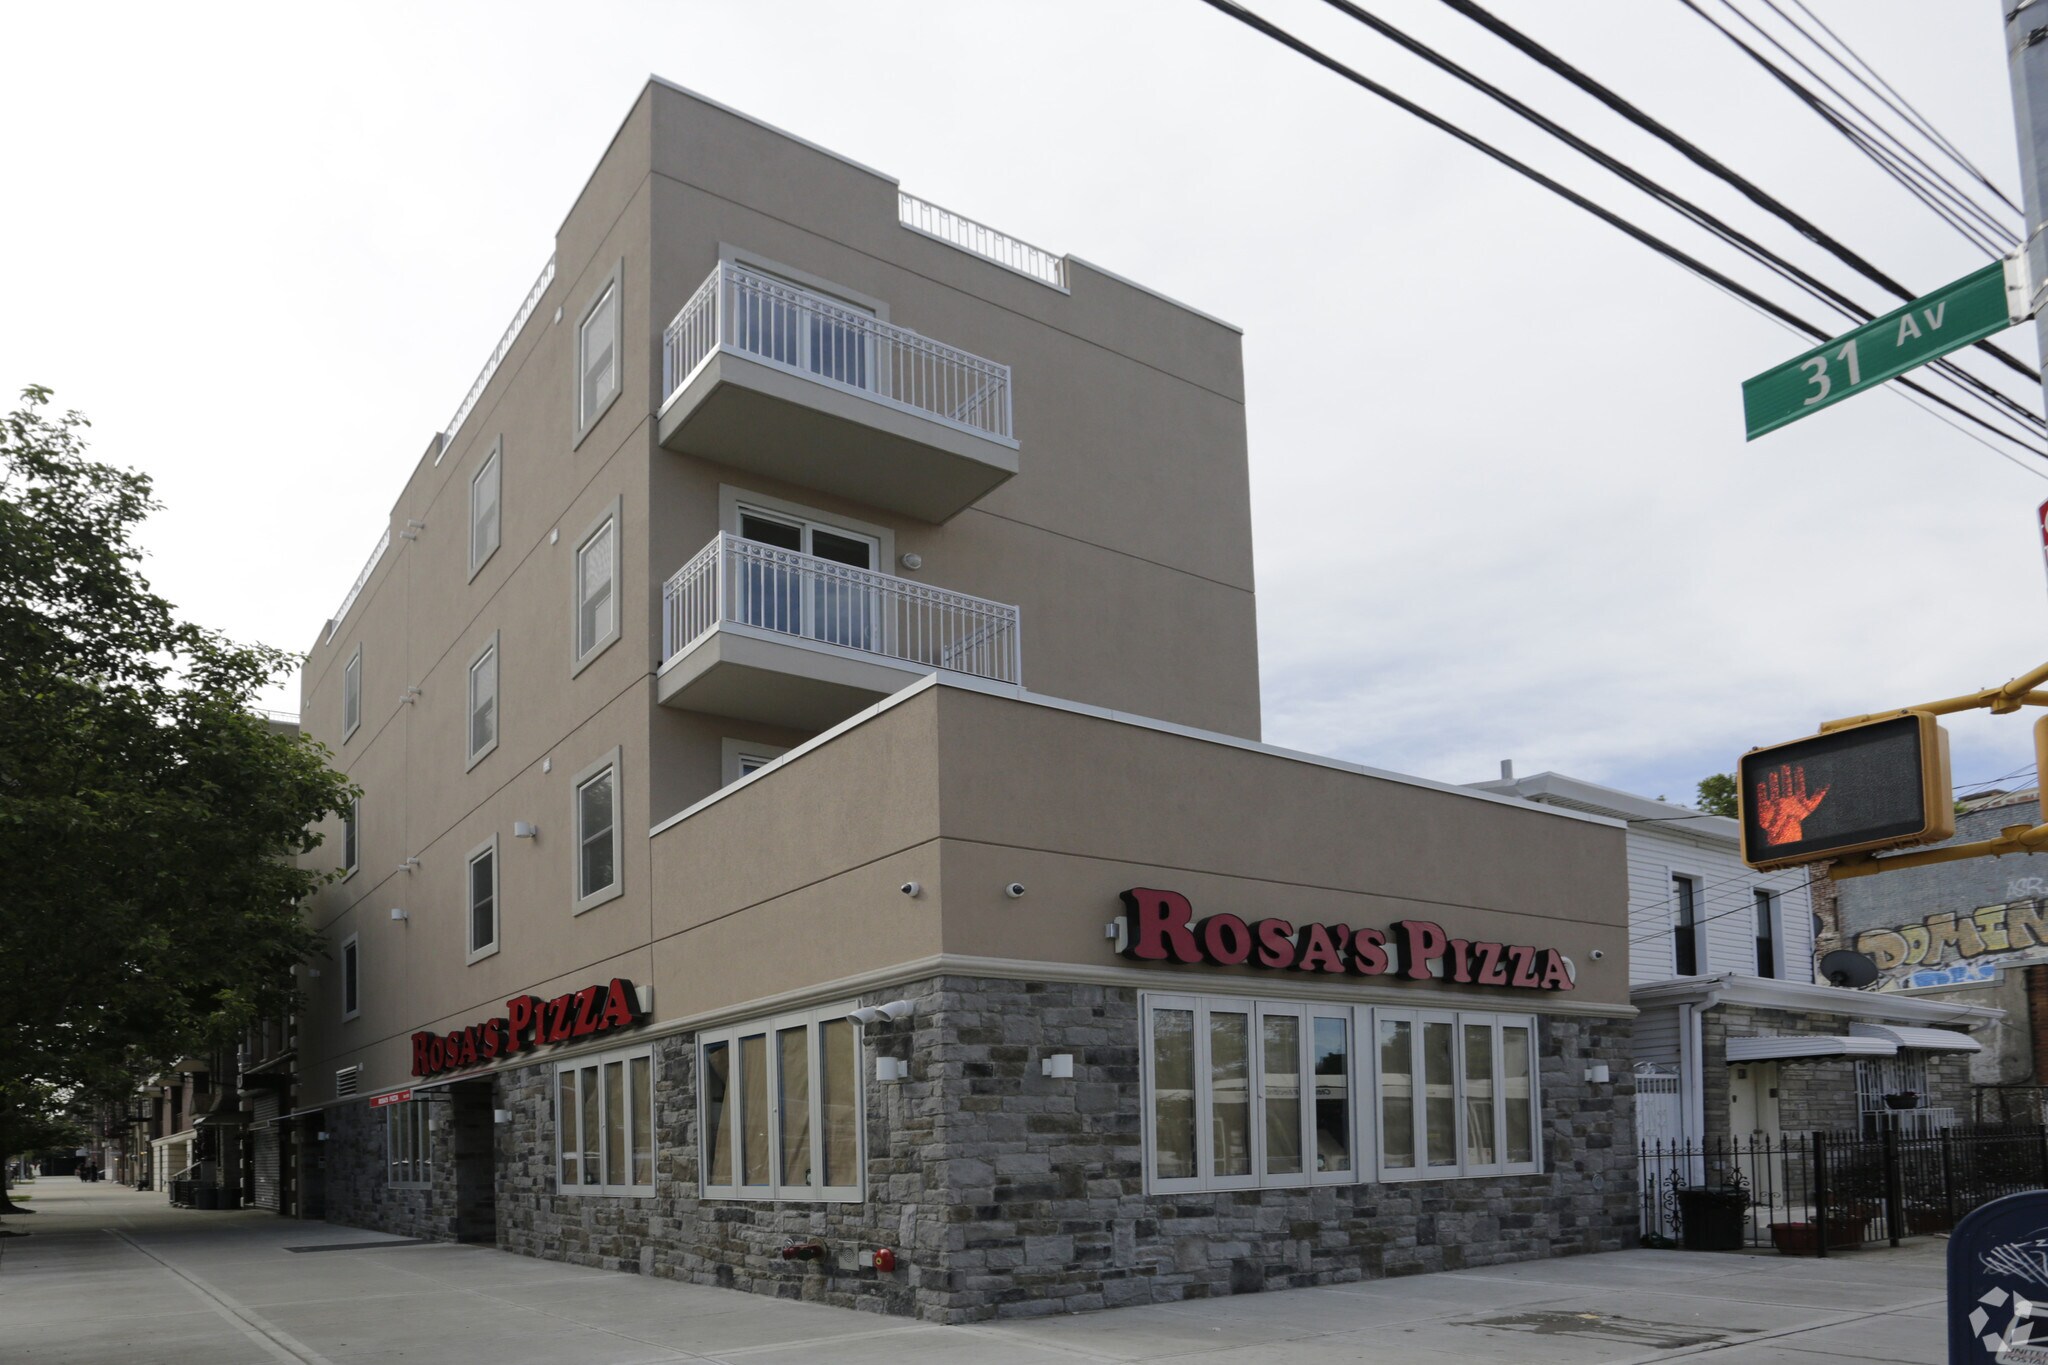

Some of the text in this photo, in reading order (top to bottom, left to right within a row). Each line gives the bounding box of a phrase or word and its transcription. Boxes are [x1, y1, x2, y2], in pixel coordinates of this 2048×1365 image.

[1801, 301, 1946, 406] 31 Av
[1127, 886, 1576, 991] ROSA'S PIZZA
[411, 977, 634, 1077] ROSA'S PIZZA
